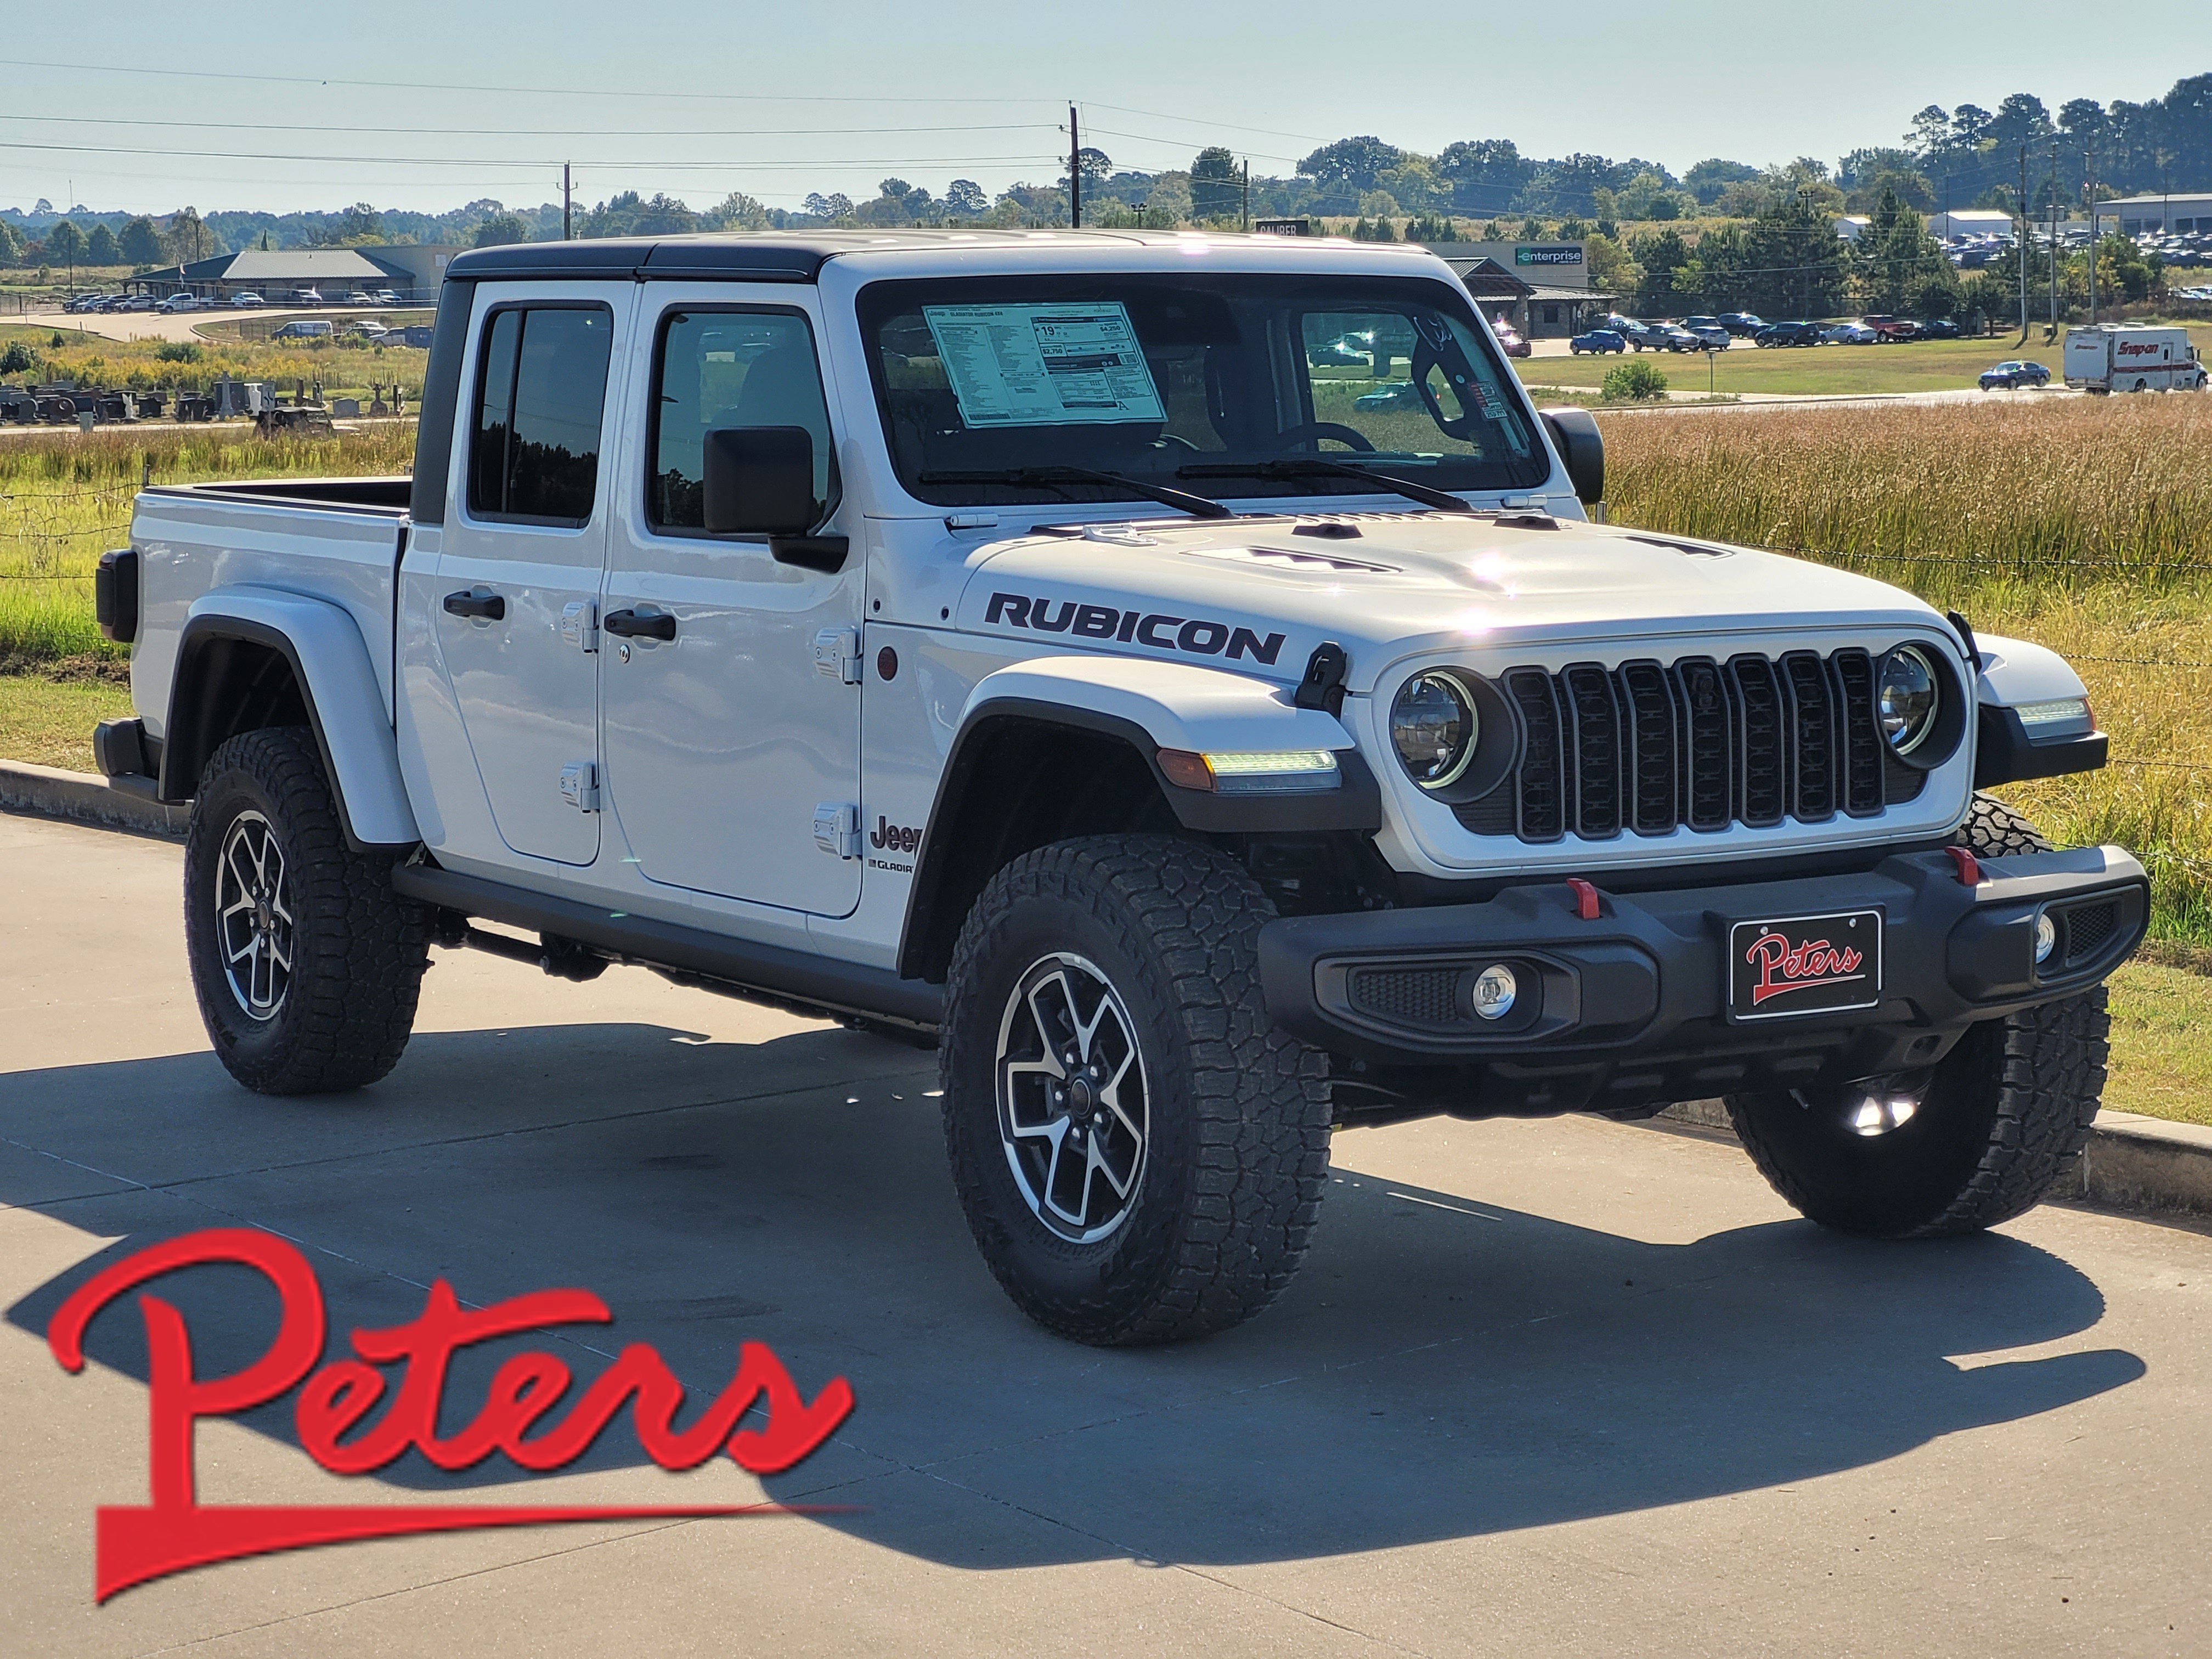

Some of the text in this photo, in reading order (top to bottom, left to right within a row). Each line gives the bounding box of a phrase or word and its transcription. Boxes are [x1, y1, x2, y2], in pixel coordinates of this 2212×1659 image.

[1518, 251, 1581, 263] enterprise
[1041, 326, 1055, 336] 19
[2118, 341, 2159, 357] Snap-on
[984, 592, 1286, 665] RUBICON
[877, 860, 914, 873] GLADIA
[1746, 933, 1865, 1001] Peters
